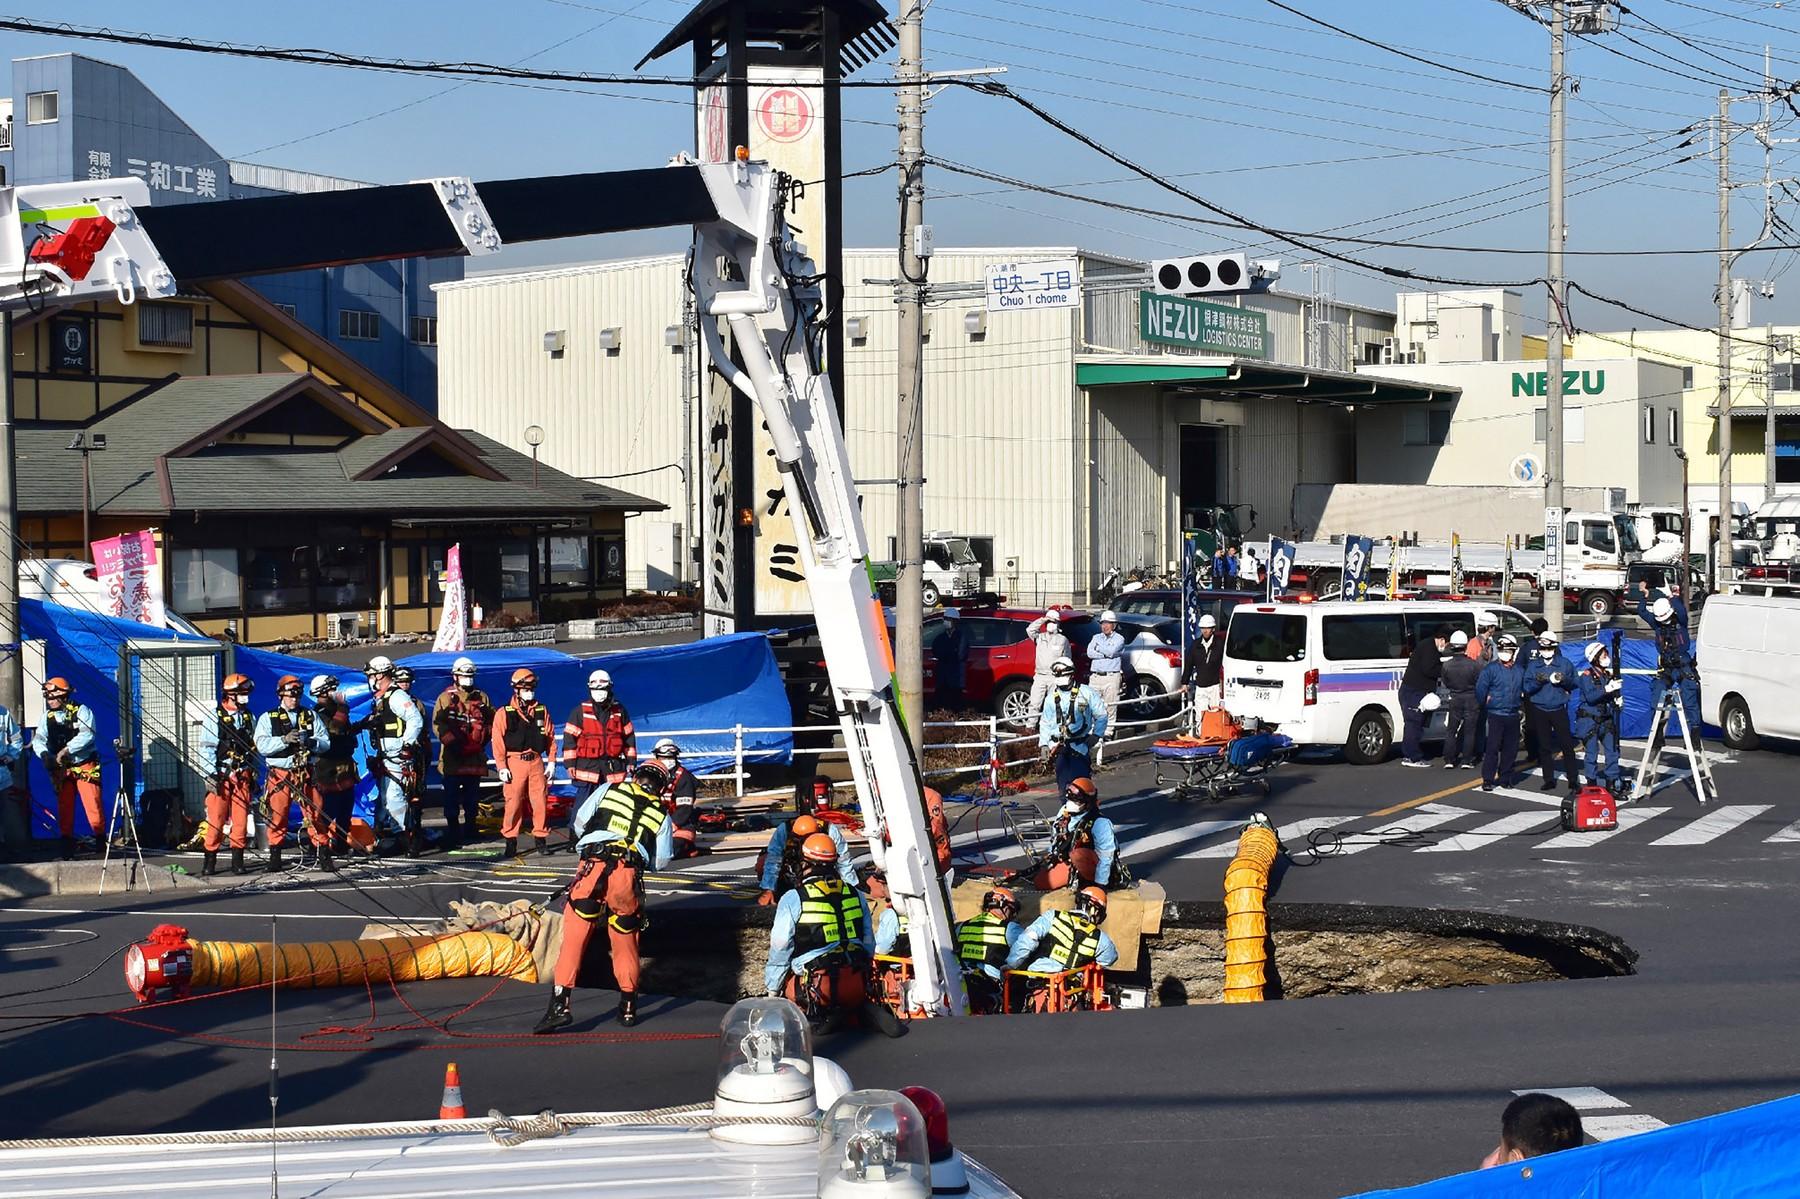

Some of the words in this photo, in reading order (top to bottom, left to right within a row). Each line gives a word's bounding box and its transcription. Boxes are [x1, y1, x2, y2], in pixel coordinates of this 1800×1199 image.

[88, 150, 111, 167] 有限
[127, 158, 216, 198] 三和工業
[993, 270, 1071, 294] 中央一丁目
[1000, 295, 1024, 307] Chuo
[1027, 294, 1032, 304] 1
[1035, 293, 1067, 304] chome
[1148, 298, 1199, 341] NEZU
[1202, 328, 1237, 348] LOGISTICS
[1237, 334, 1263, 351] CENTER
[1512, 370, 1605, 397] NEZU
